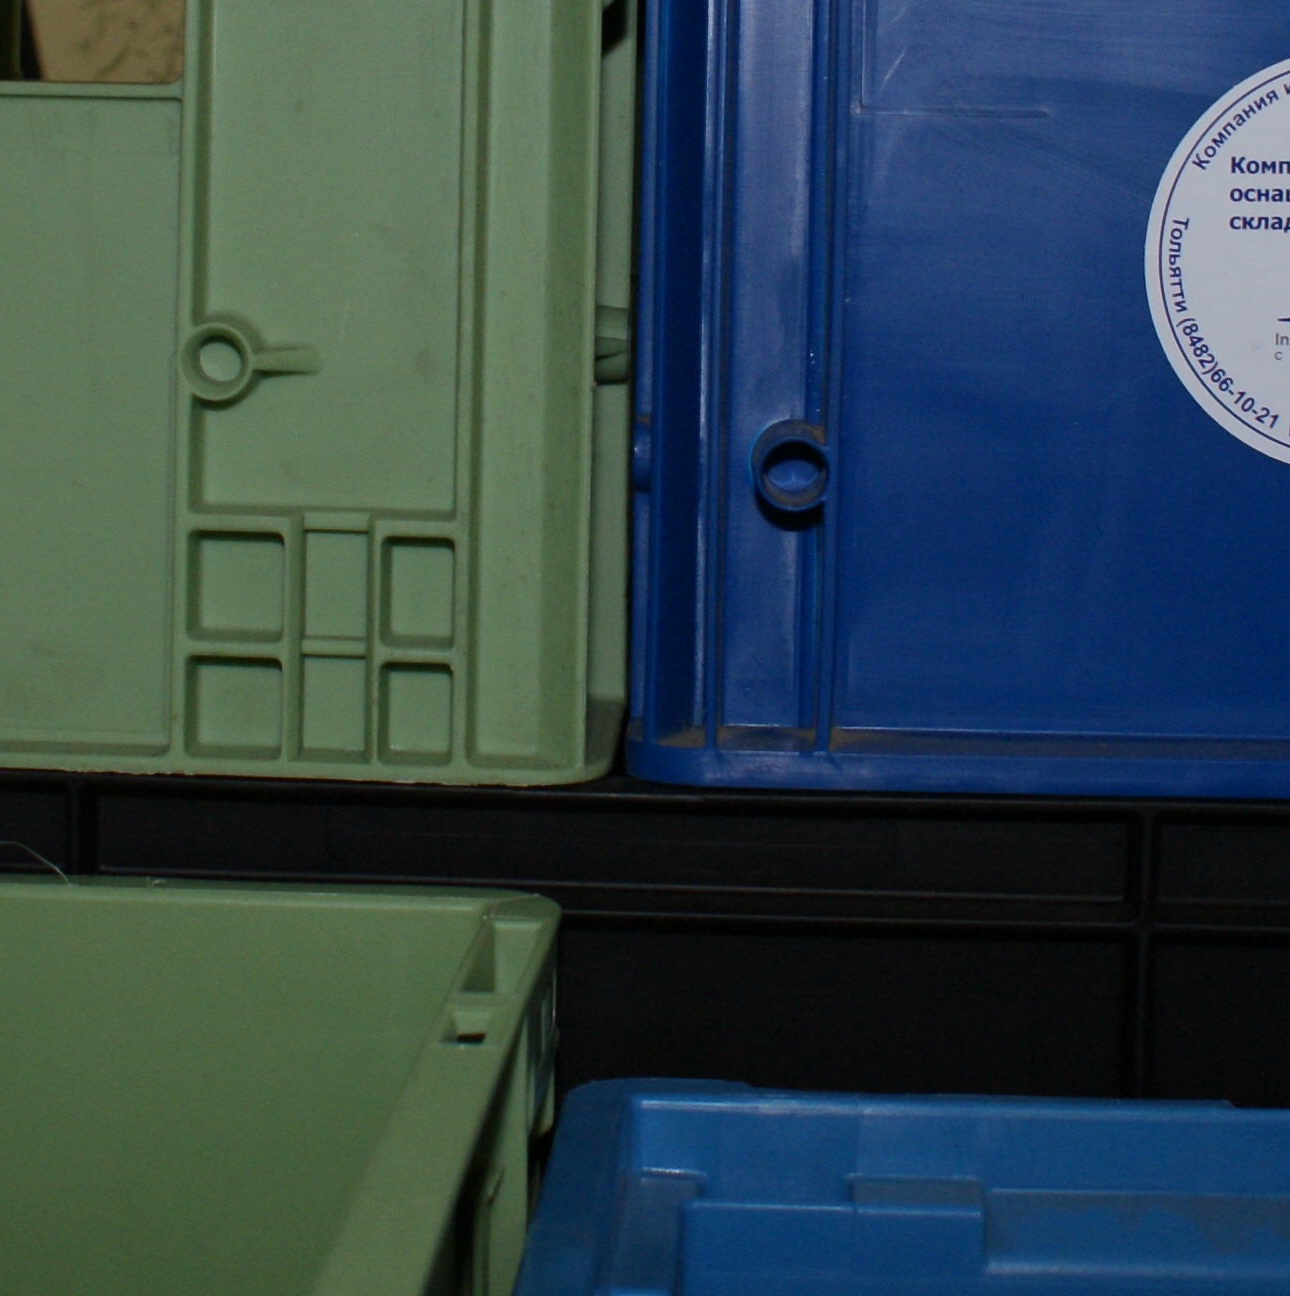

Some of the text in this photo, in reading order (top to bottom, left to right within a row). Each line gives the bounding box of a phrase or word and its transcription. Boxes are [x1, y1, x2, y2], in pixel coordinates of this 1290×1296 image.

[1192, 89, 1279, 170] Компания
[1168, 217, 1190, 313] Тольятти
[1175, 318, 1280, 429] (8482)66-10-21
